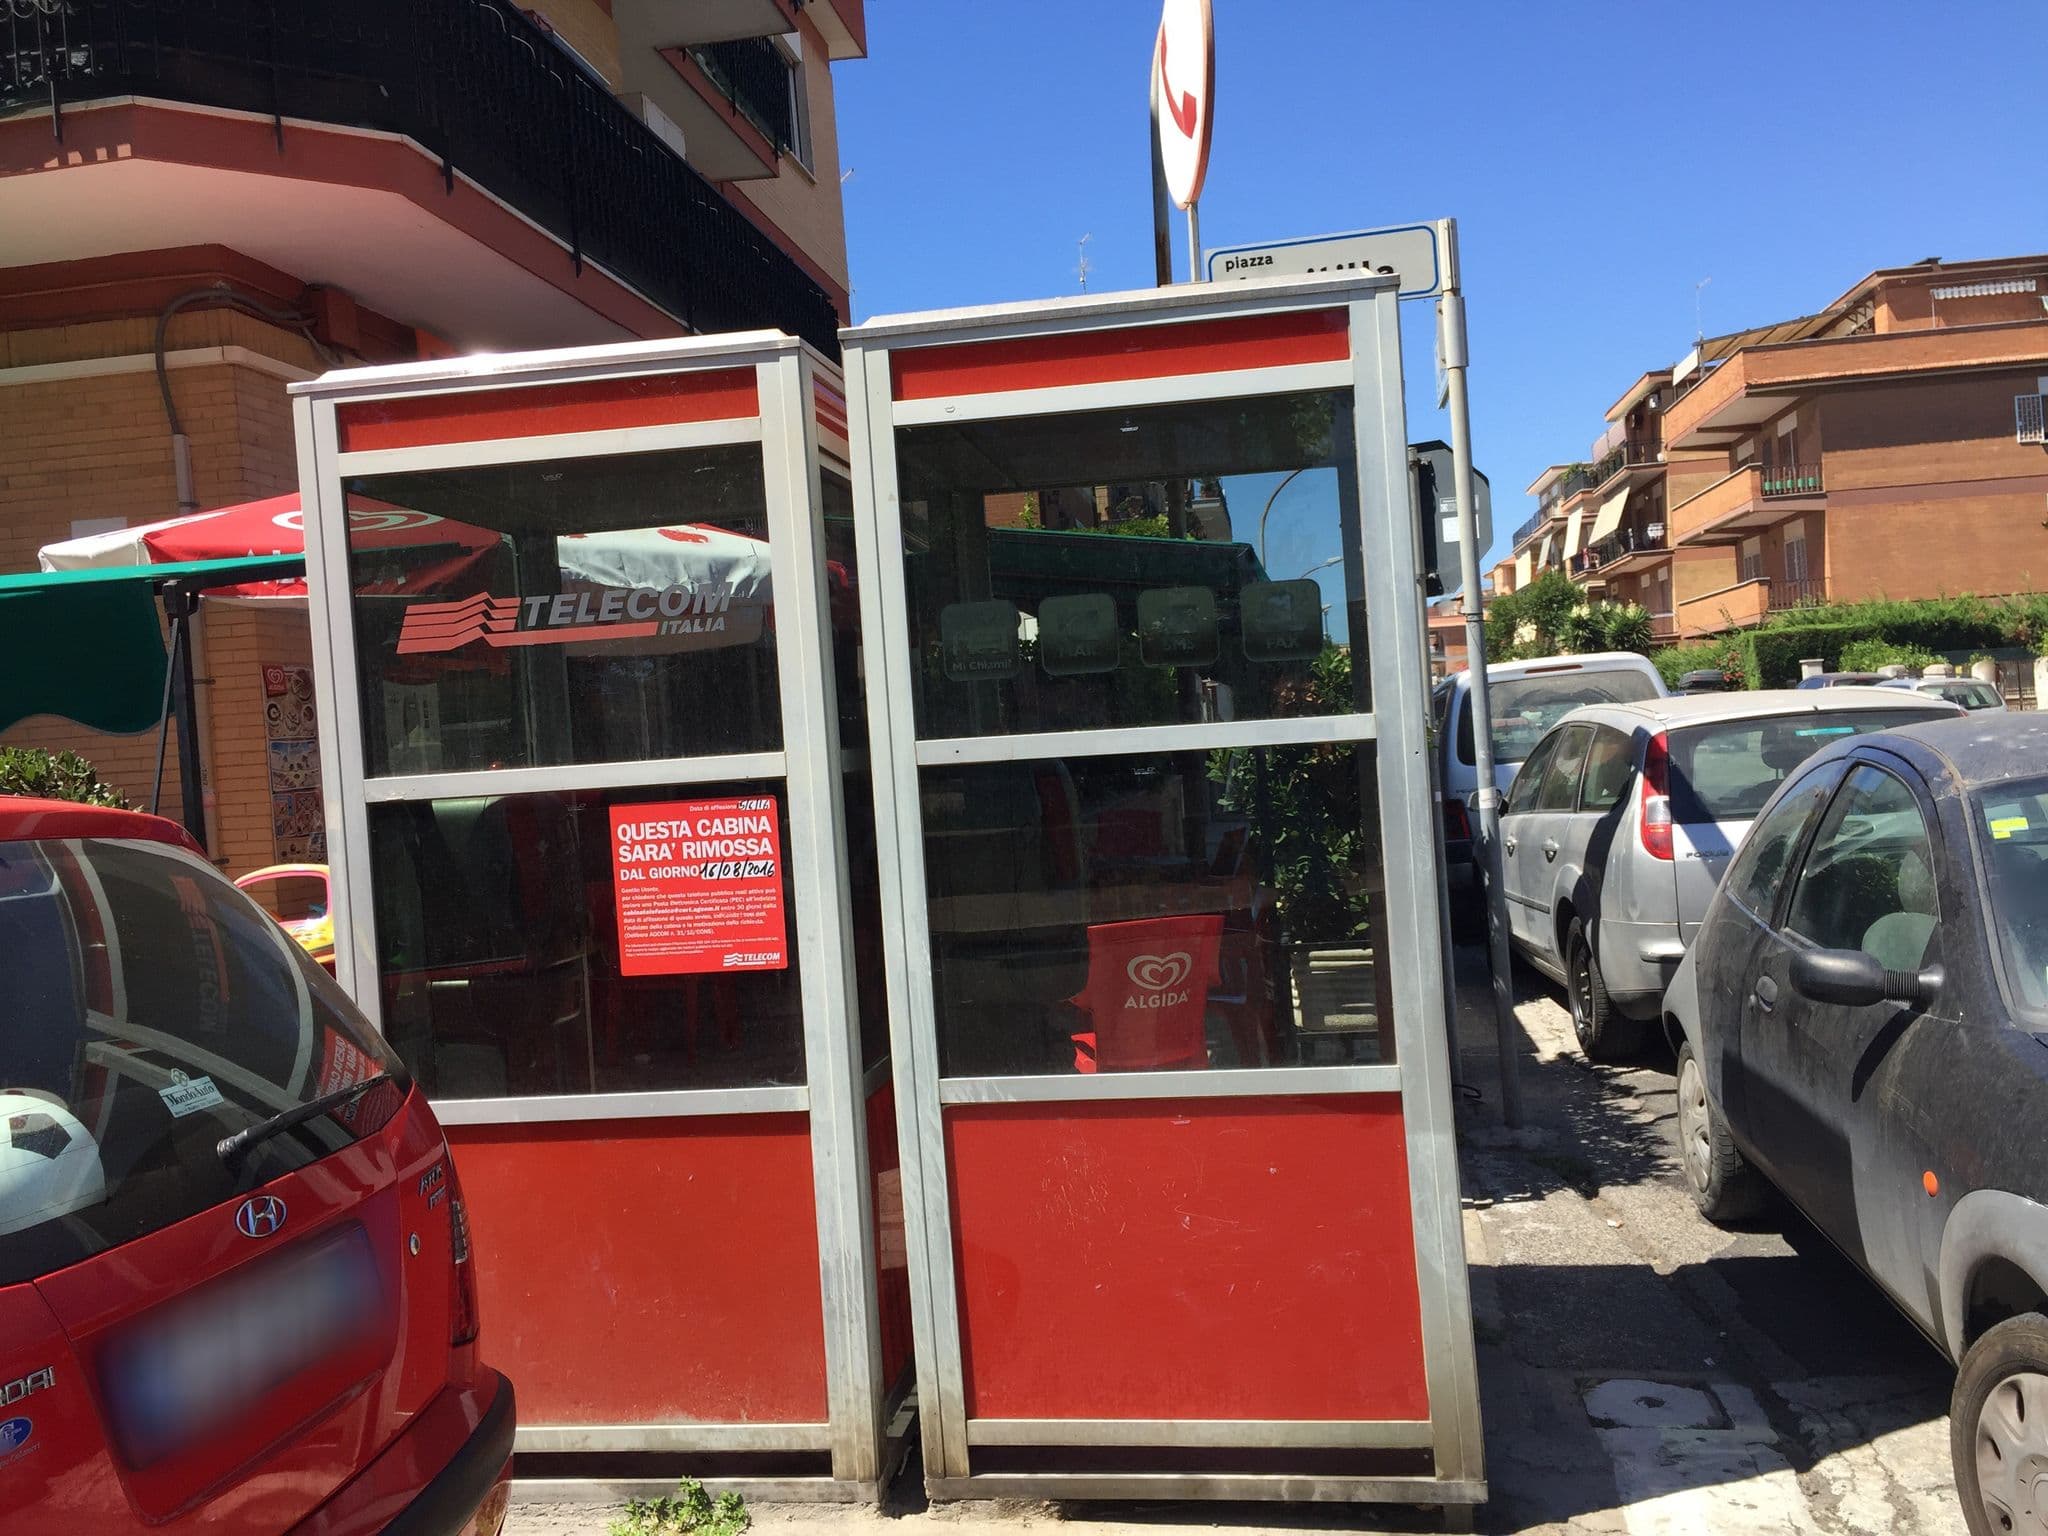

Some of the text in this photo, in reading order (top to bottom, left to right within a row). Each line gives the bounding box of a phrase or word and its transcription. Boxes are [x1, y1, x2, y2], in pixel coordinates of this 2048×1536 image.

[1225, 253, 1274, 272] piazza
[524, 581, 734, 627] TELECOM
[660, 616, 726, 636] ITALIA
[616, 815, 772, 844] QUESTA CABINA
[618, 837, 774, 863] SARA' RIMOSSA
[620, 865, 700, 881] DAL GIORNO
[699, 857, 775, 882] 16/08/2016
[742, 952, 780, 962] TELECOM
[1124, 990, 1189, 1009] ALGIDA
[0, 1366, 56, 1407] DAI
